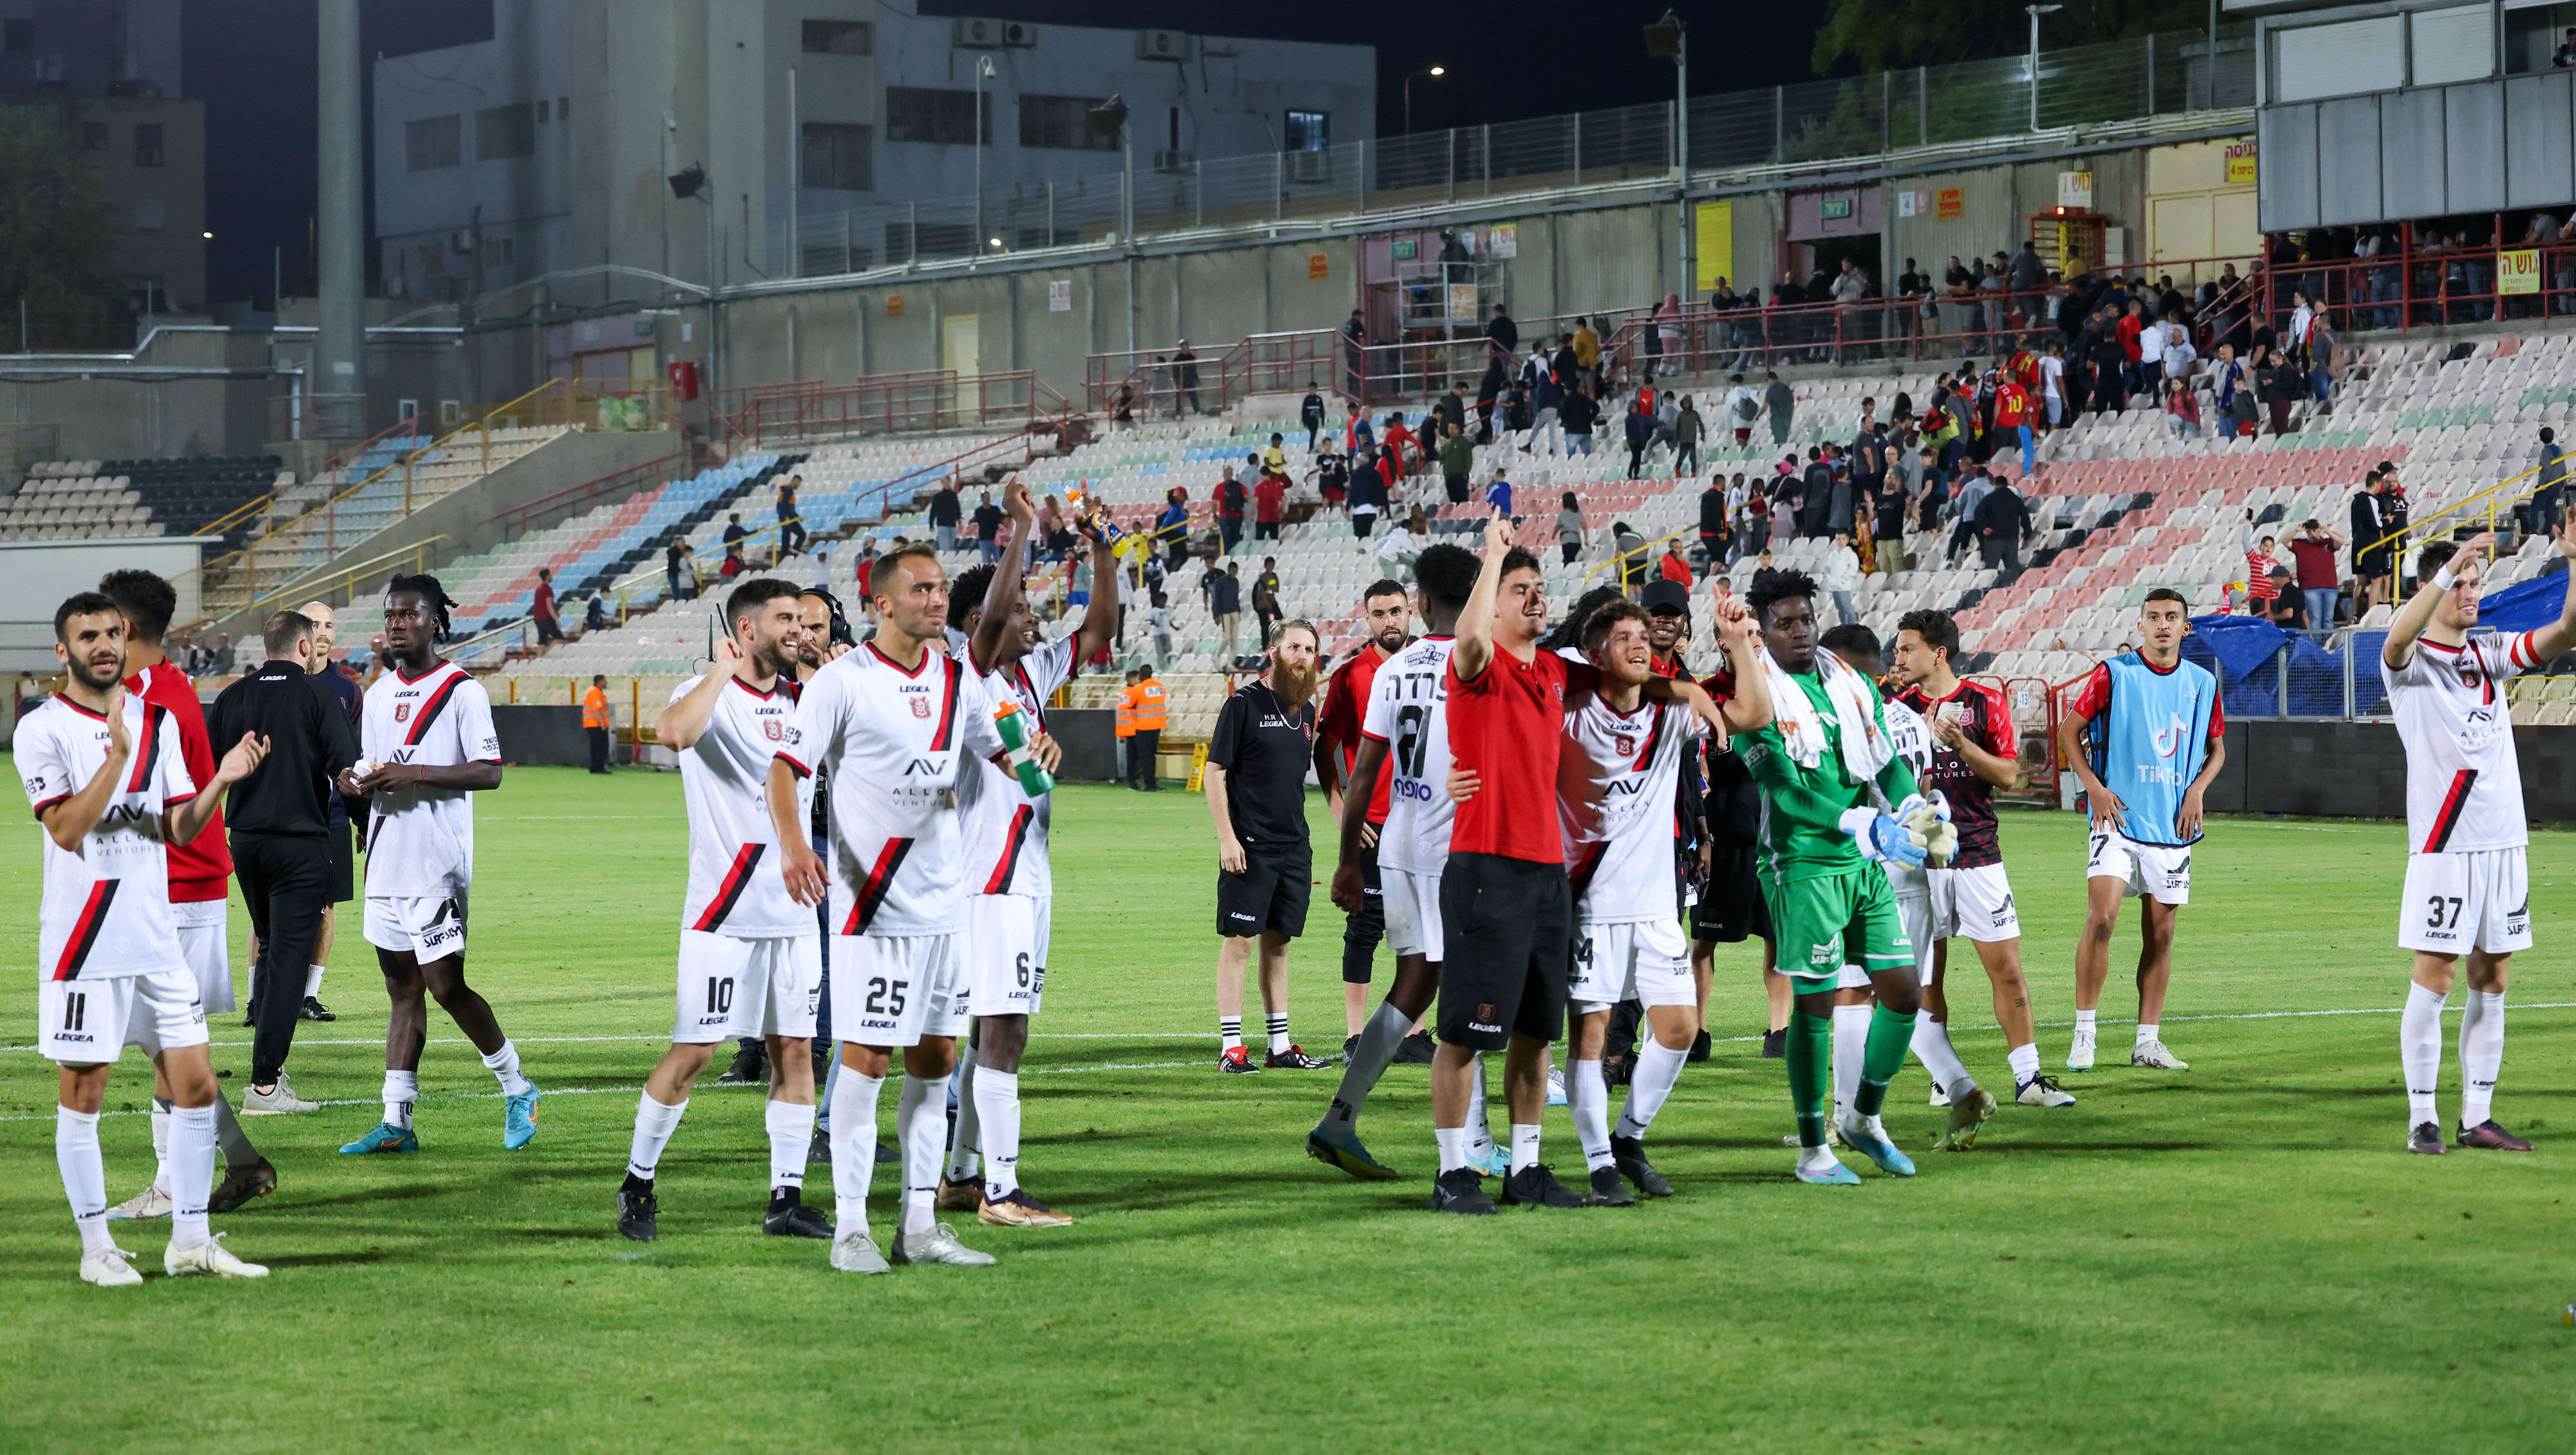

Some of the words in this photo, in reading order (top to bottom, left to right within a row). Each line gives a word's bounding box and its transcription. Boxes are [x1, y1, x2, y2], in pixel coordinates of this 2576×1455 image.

[2225, 144, 2256, 158] ניסה
[2231, 165, 2235, 175] 4
[2237, 166, 2253, 176] כניסה
[2516, 254, 2539, 274] גוש
[1931, 770, 1975, 779] TURES
[2137, 765, 2184, 786] TikTo
[893, 788, 945, 796] ALLO
[97, 833, 158, 845] ALLON
[97, 844, 160, 857] VENTURES
[1231, 912, 1256, 922] LEGEA
[2428, 895, 2463, 929] 37
[2425, 931, 2457, 939] LEGEA
[1016, 952, 1028, 987] 6
[708, 976, 734, 1013] 10
[866, 977, 909, 1016] 25
[64, 993, 85, 1031] 11
[861, 1020, 896, 1029] LEGEA
[1468, 1022, 1502, 1032] LEGEA
[54, 1033, 93, 1042] LEGEA
